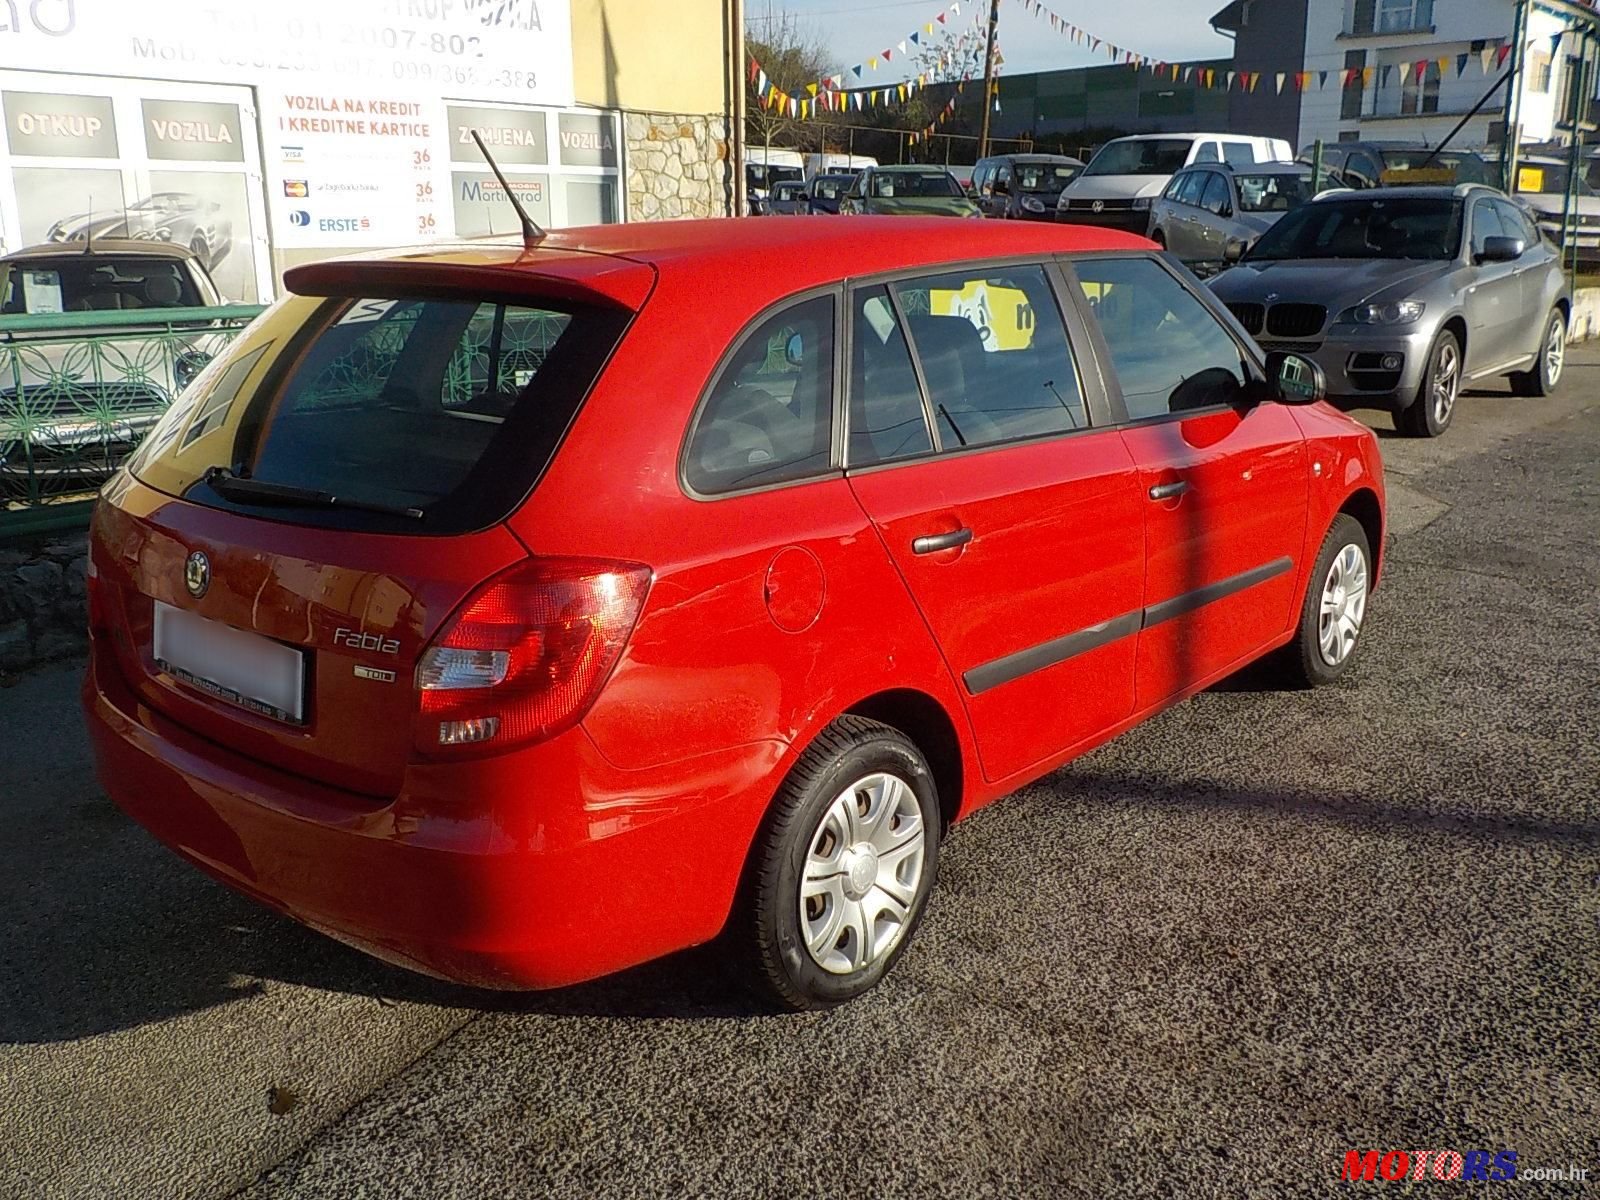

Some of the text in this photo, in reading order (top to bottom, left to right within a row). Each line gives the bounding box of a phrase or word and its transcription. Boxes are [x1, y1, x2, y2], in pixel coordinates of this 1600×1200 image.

[284, 95, 421, 118] VOZILA NA KREDIT
[17, 112, 102, 138] OTKUP
[152, 119, 233, 144] VOZILA
[279, 116, 431, 138] I KREDITNE KARTICE
[561, 132, 613, 150] VOZILA
[413, 148, 431, 165] 36
[416, 180, 433, 197] 36
[461, 181, 542, 202] Martirad
[483, 182, 540, 190] AUTMOBILI
[319, 218, 360, 232] ERSTE
[419, 212, 436, 230] 36
[333, 627, 401, 655] Fabia
